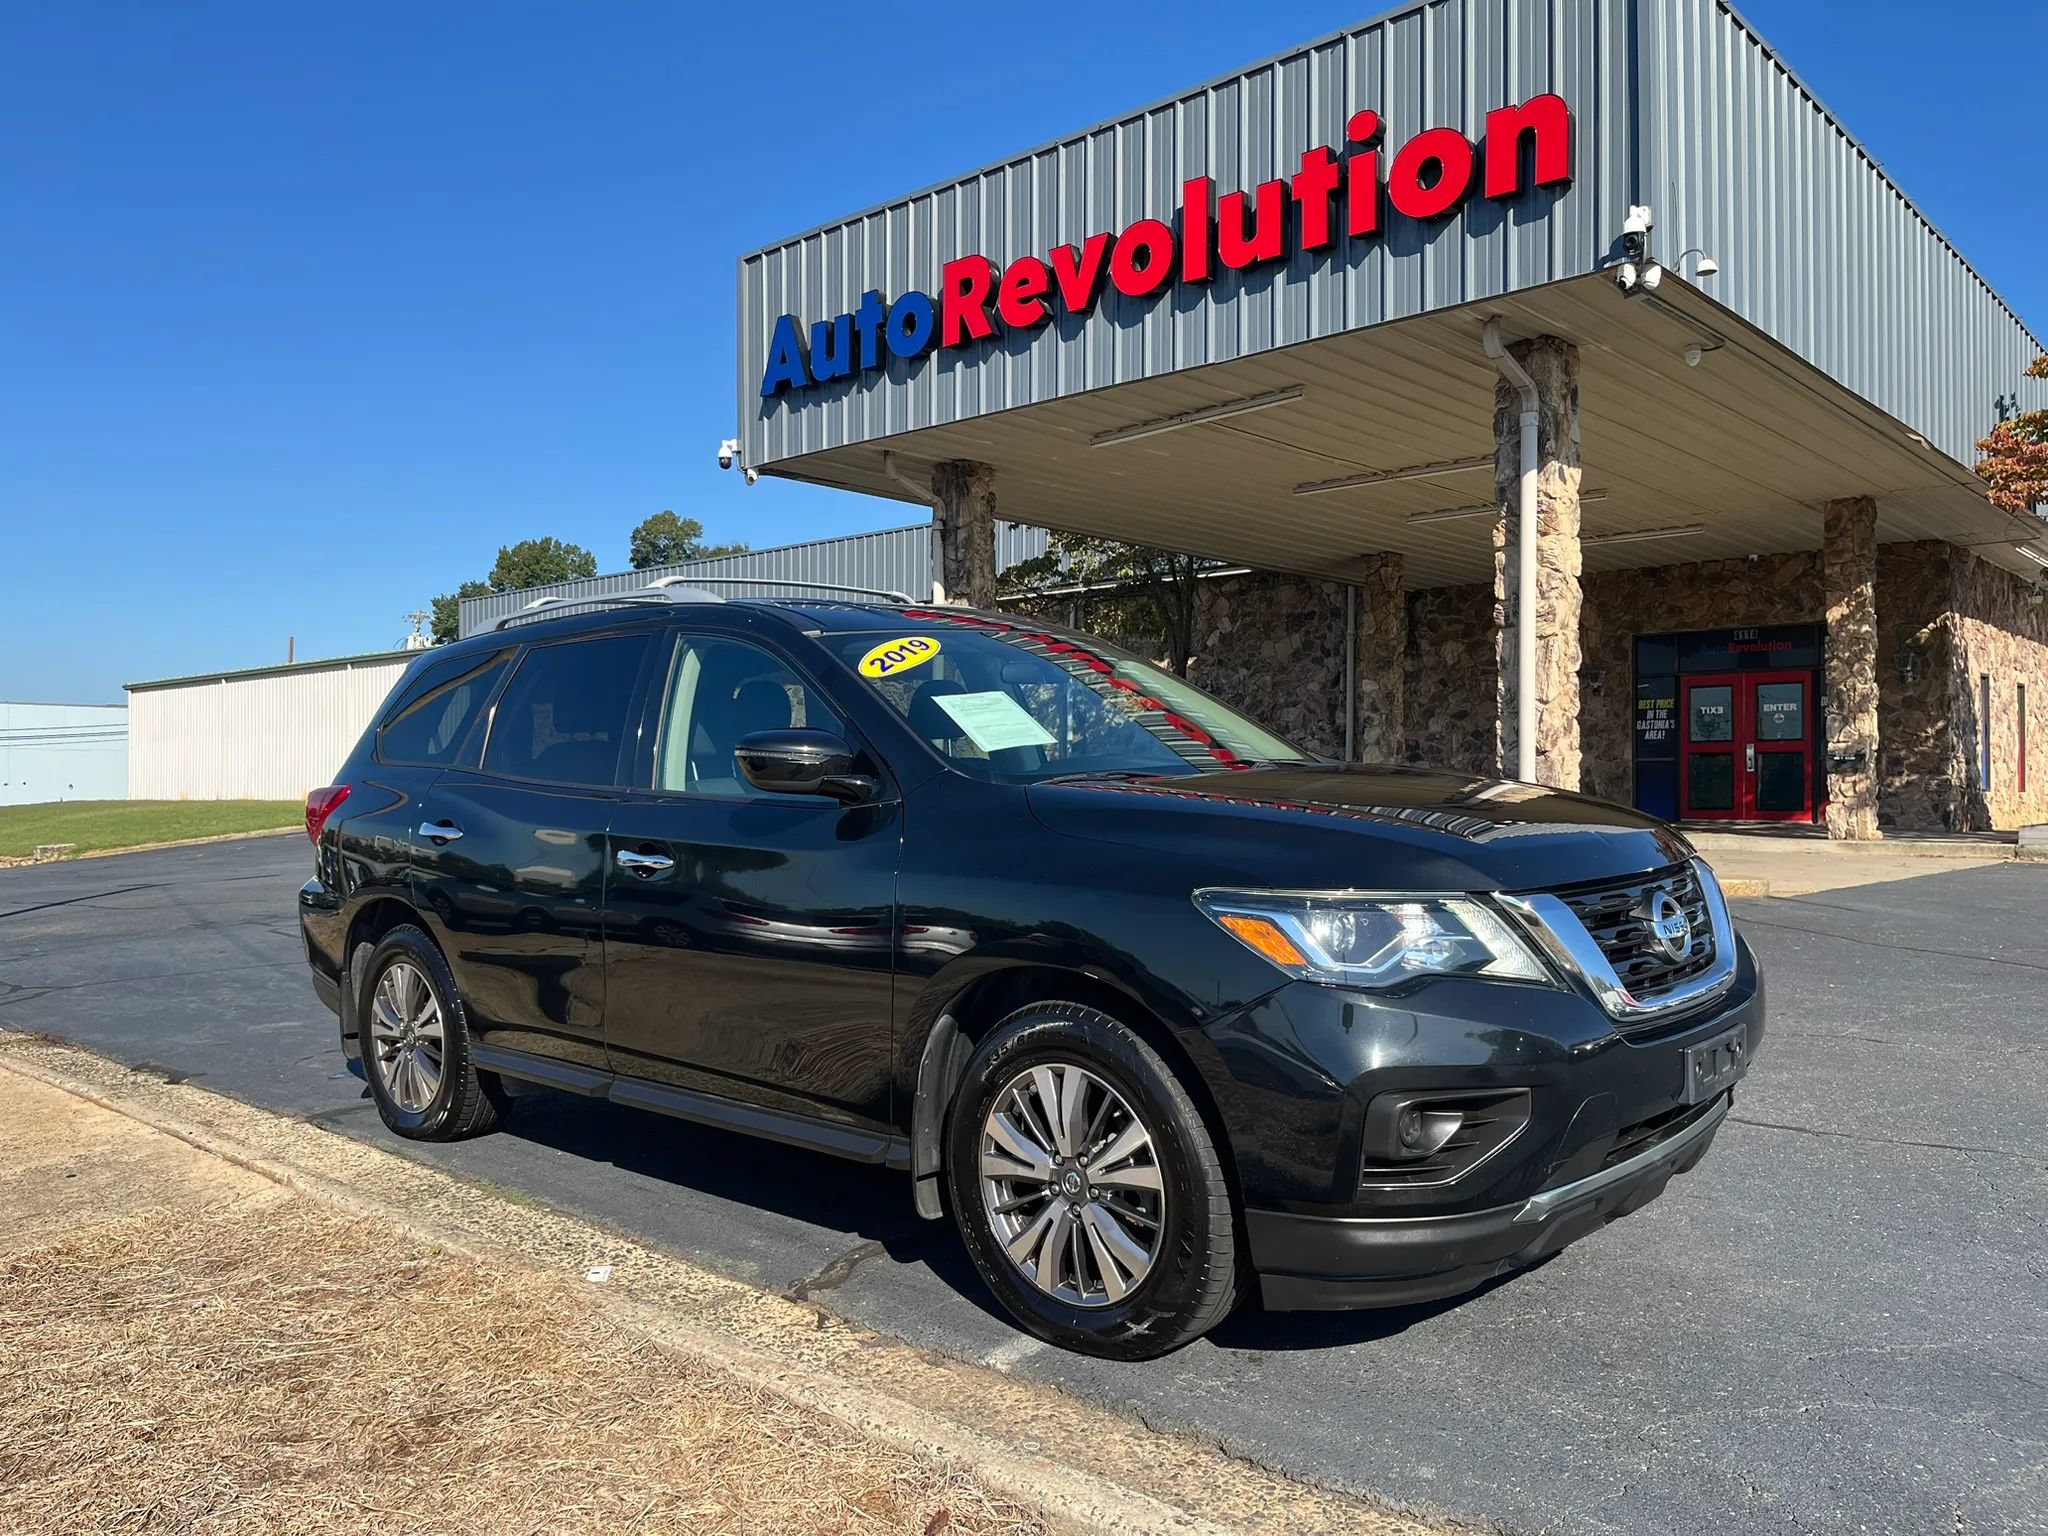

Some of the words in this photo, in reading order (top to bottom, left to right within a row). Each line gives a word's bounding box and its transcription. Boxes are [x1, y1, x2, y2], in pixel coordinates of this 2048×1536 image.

[869, 639, 930, 673] 2019
[1638, 700, 1655, 709] BEST
[1656, 699, 1675, 708] PRICE
[1763, 703, 1797, 712] ENTER
[1646, 710, 1655, 719] IN
[1656, 709, 1668, 719] THE
[1636, 719, 1676, 730] GASTONIA'S
[1644, 730, 1666, 740] AREA!
